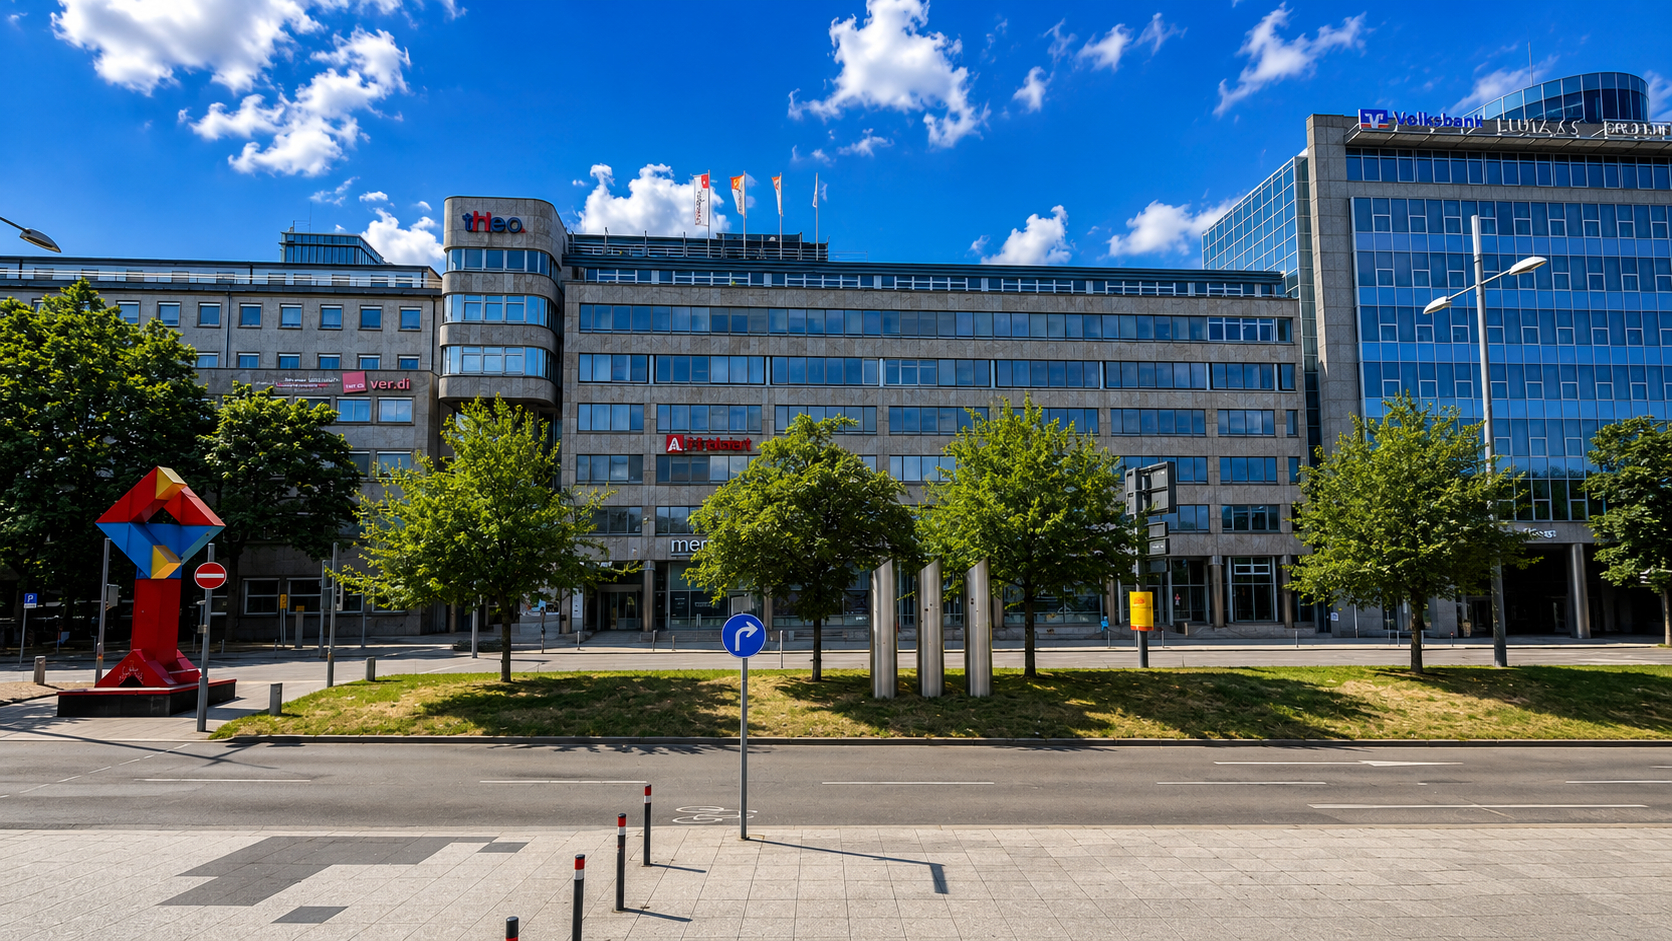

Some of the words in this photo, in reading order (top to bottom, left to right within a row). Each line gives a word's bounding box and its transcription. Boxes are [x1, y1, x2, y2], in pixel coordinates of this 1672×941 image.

[1393, 111, 1483, 128] Volksbank
[370, 378, 410, 390] ver.di
[671, 539, 713, 552] mer
